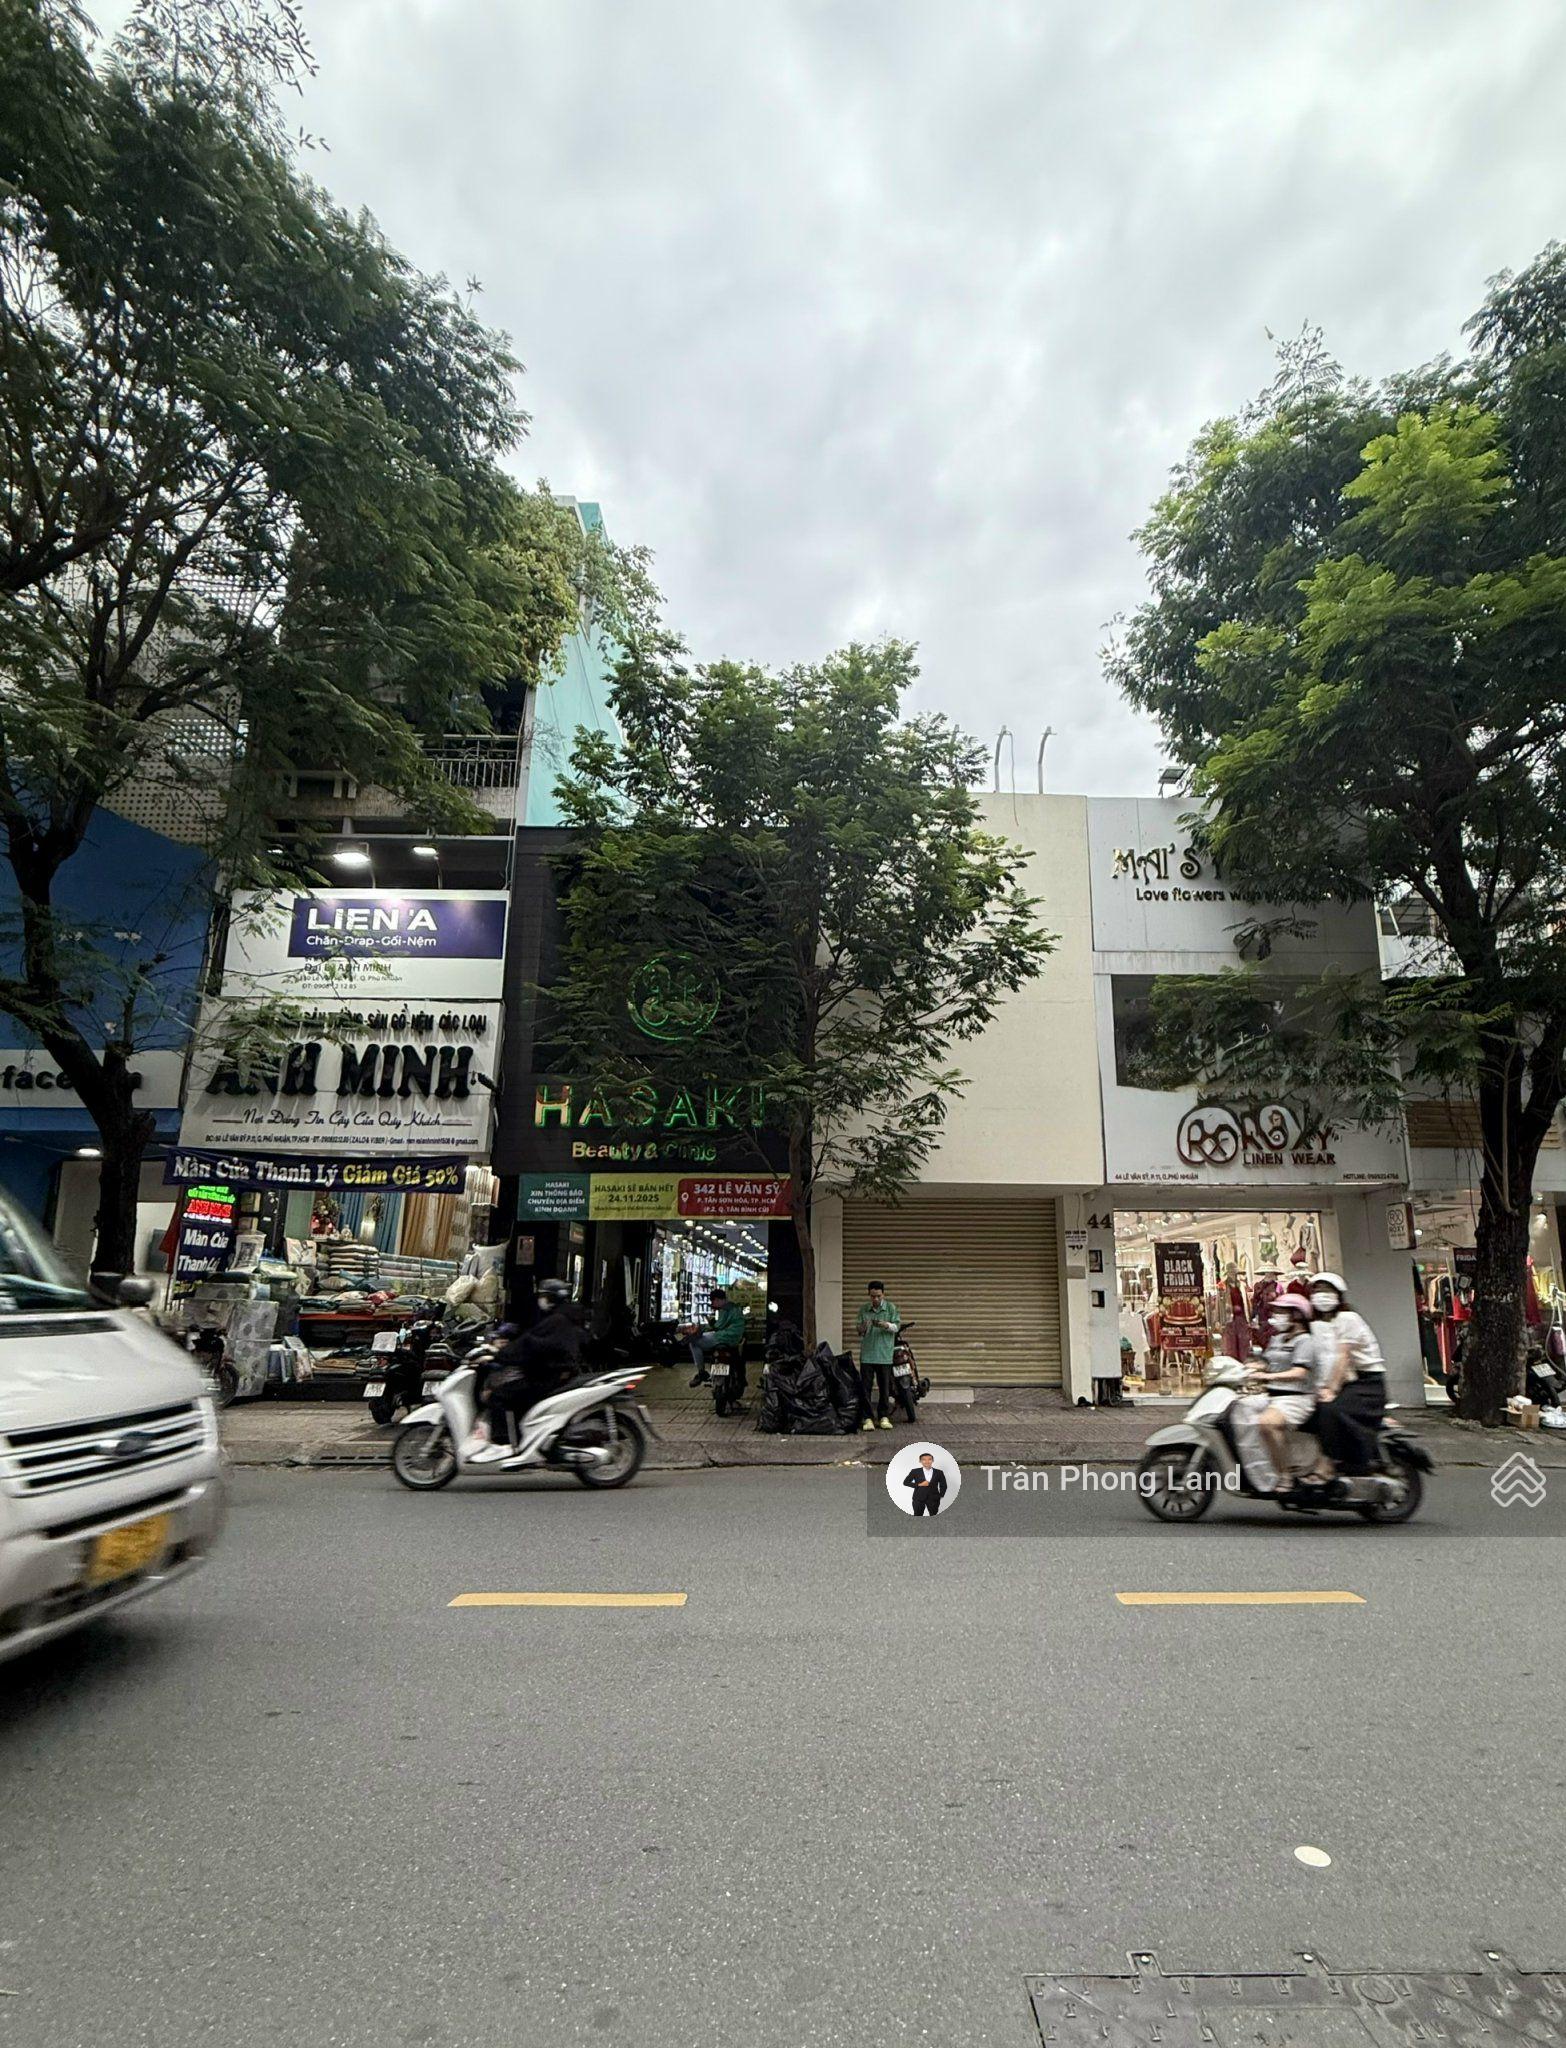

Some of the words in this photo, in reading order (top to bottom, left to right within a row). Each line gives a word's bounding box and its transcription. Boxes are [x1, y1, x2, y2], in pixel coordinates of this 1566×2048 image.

[1136, 887, 1169, 901] Love
[1172, 887, 1225, 901] flowers
[337, 1043, 474, 1098] MINH
[534, 1085, 766, 1128] HASAKI
[304, 1111, 324, 1125] Tin
[378, 1111, 402, 1129] Quý
[404, 1110, 441, 1127] Khách
[572, 1141, 642, 1161] Beauty
[1243, 1152, 1283, 1165] LINEN
[1291, 1152, 1336, 1165] WEAR
[173, 1156, 210, 1179] Màn
[255, 1161, 314, 1183] Thanh
[317, 1164, 338, 1187] Lý
[343, 1163, 388, 1185] Giảm
[392, 1165, 422, 1186] Giá
[425, 1165, 459, 1187] 50%
[594, 1184, 626, 1193] HASAKI
[693, 1183, 715, 1194] 342
[718, 1181, 732, 1194] LÊ
[734, 1181, 762, 1194] VĂN
[608, 1193, 660, 1203] 24.11.2025
[1087, 1213, 1113, 1229] 44
[177, 1255, 209, 1272] Thanh
[1456, 1254, 1478, 1262] FRIDA
[1164, 1259, 1194, 1273] BLACK
[1163, 1273, 1195, 1286] FRIDAY
